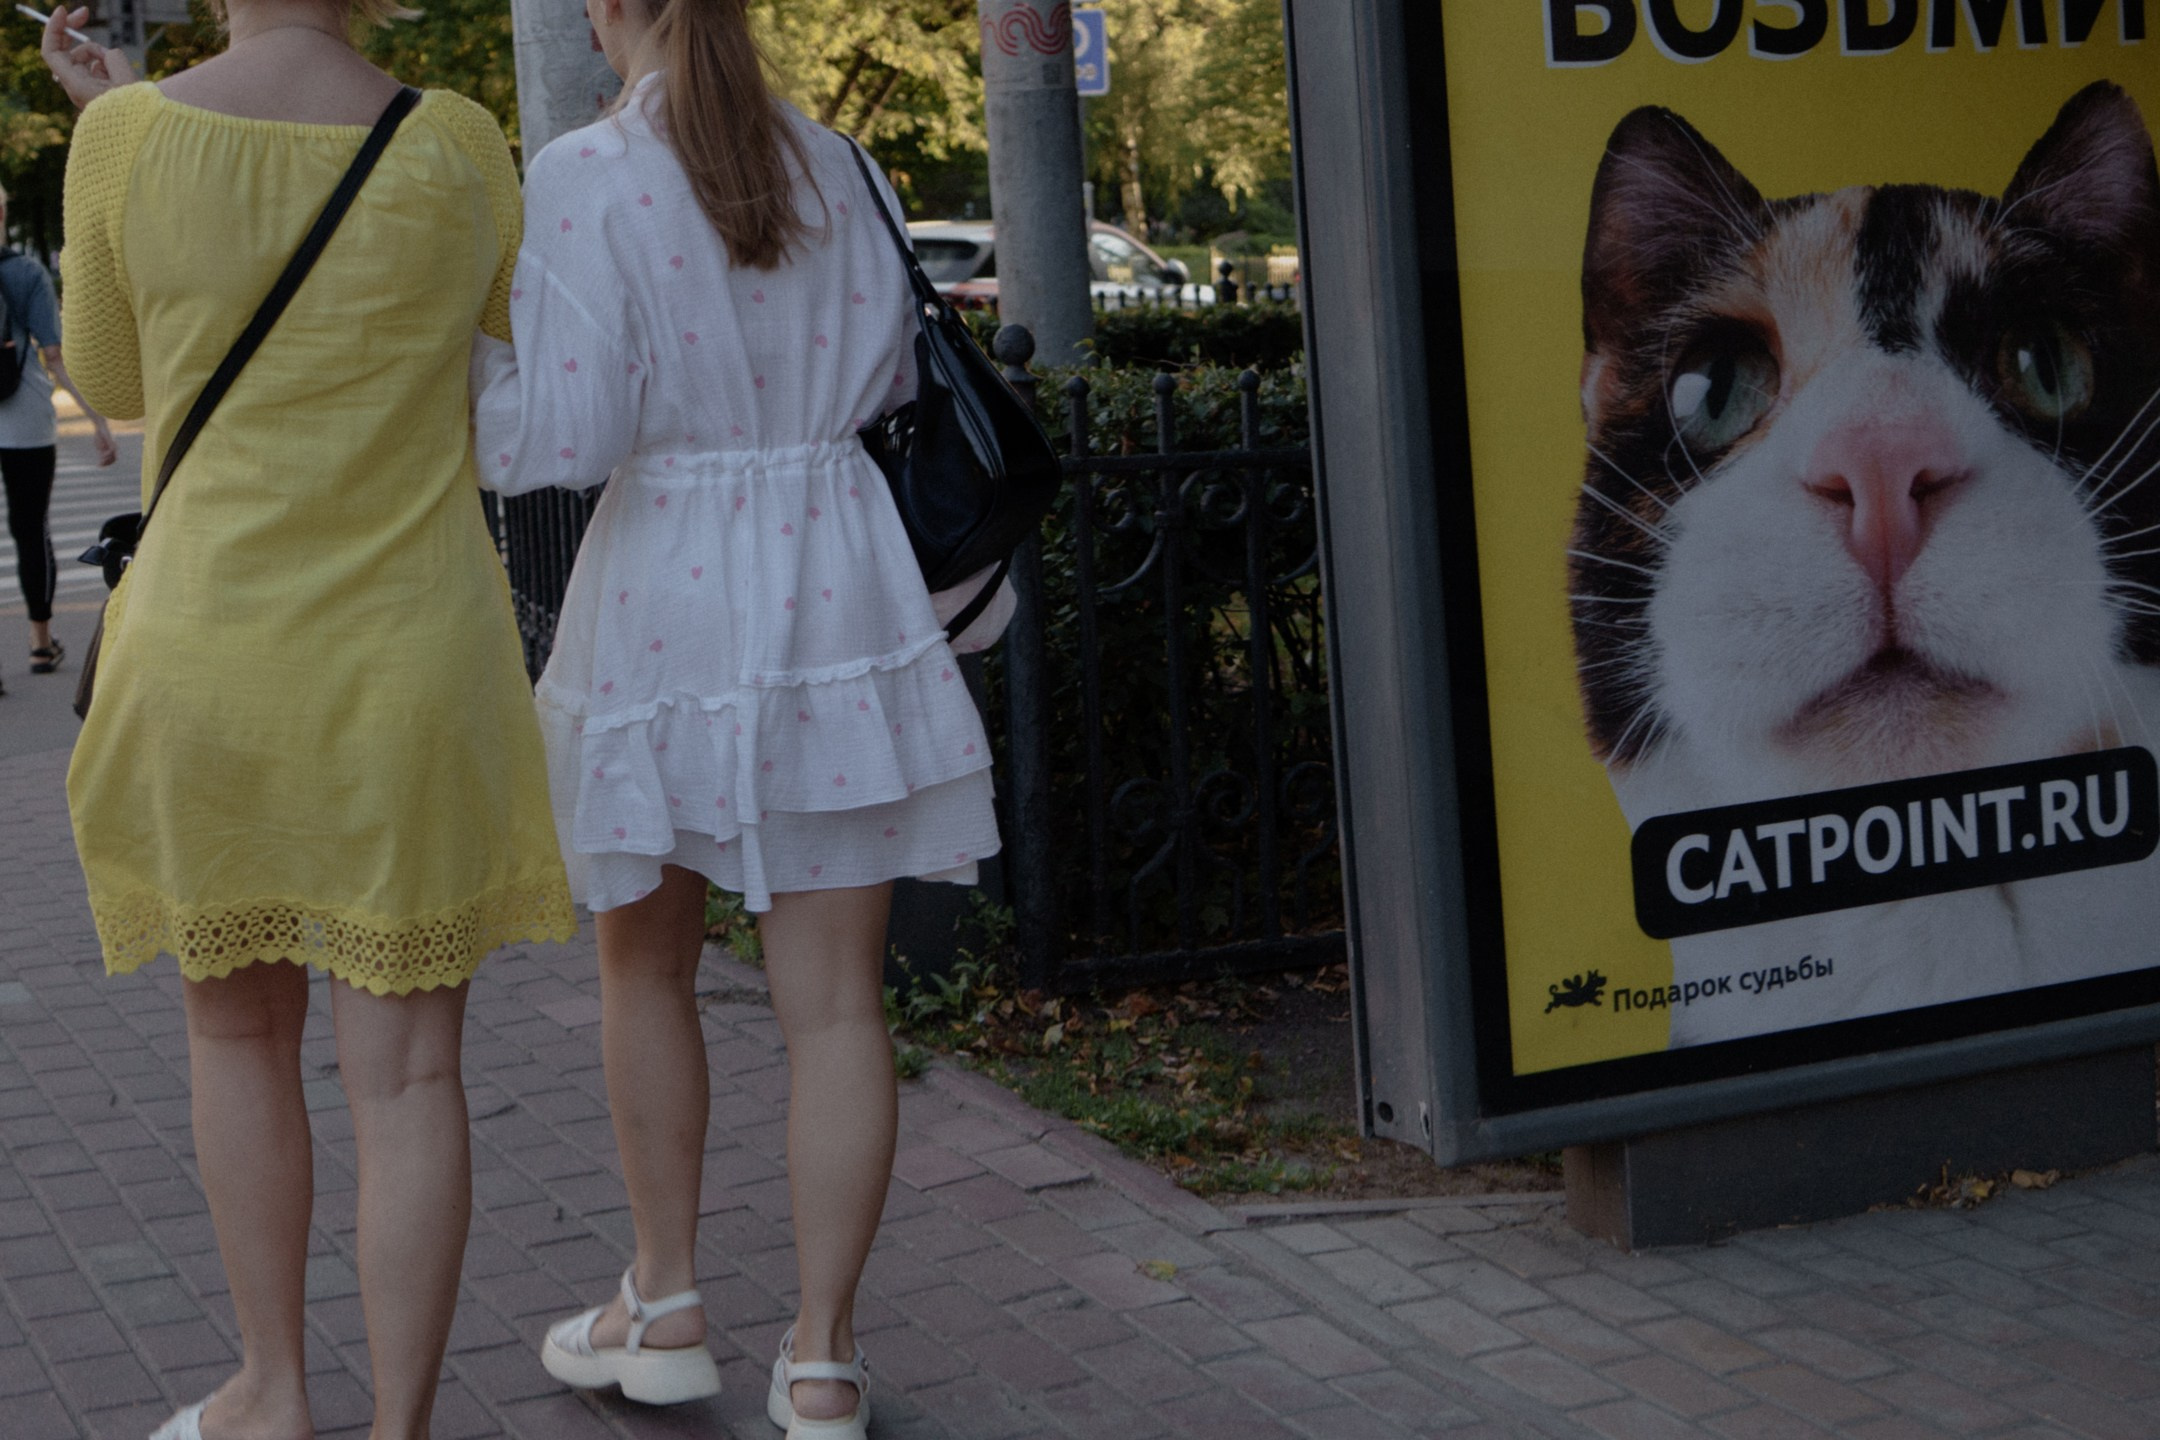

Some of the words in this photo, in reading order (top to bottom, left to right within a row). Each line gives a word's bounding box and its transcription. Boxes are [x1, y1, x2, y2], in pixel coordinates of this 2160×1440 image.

[1665, 769, 2130, 904] CATPOINT.RU
[1613, 975, 1732, 1012] Подарок
[1739, 955, 1834, 994] судьбы
